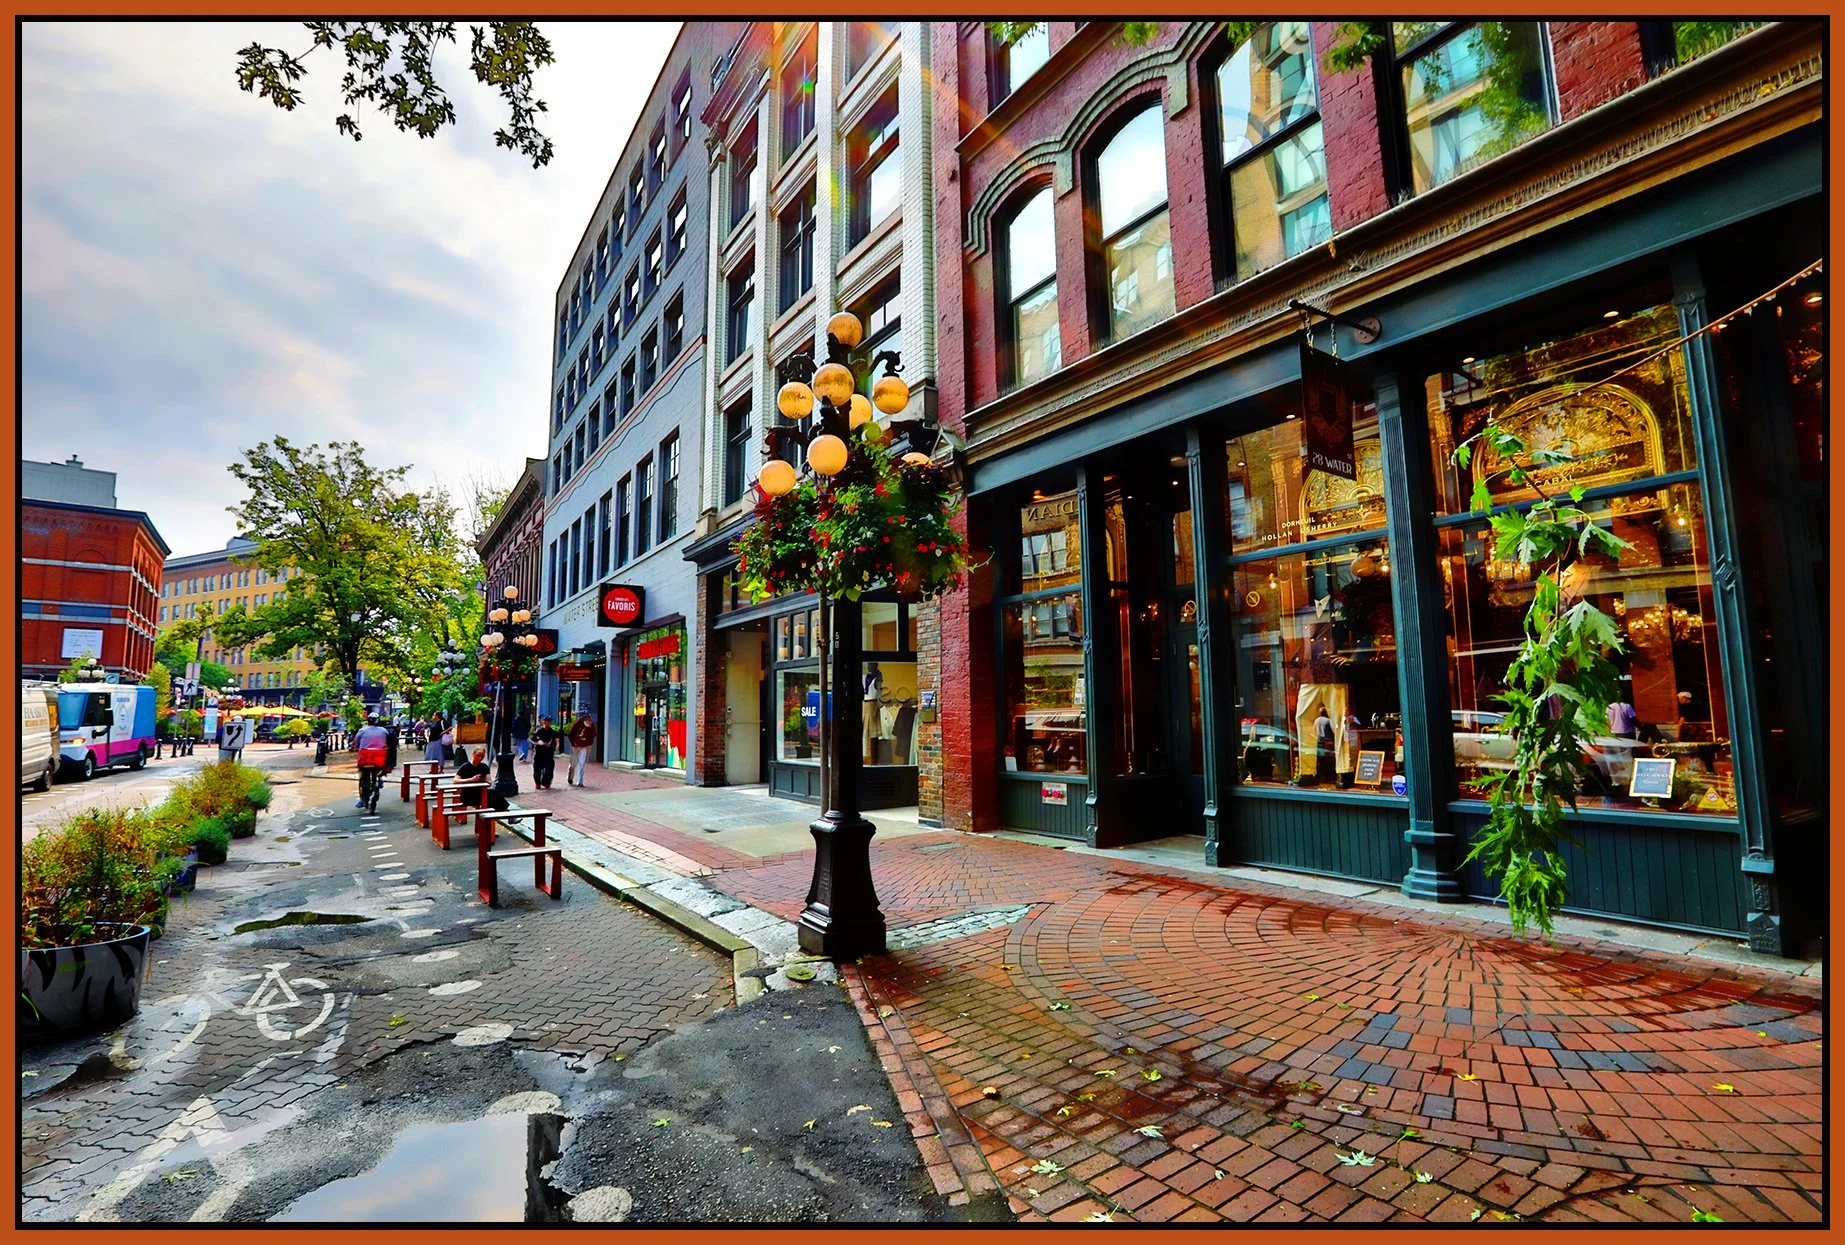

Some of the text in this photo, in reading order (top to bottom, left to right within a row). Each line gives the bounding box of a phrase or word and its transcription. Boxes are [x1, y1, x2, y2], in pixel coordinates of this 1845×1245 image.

[1312, 451, 1353, 475] 28 WATER
[1525, 474, 1577, 490] SCABAL
[1261, 530, 1294, 542] HOLLAN
[581, 595, 600, 618] STREE
[607, 600, 636, 612] FAVORIS
[801, 706, 817, 717] SALE
